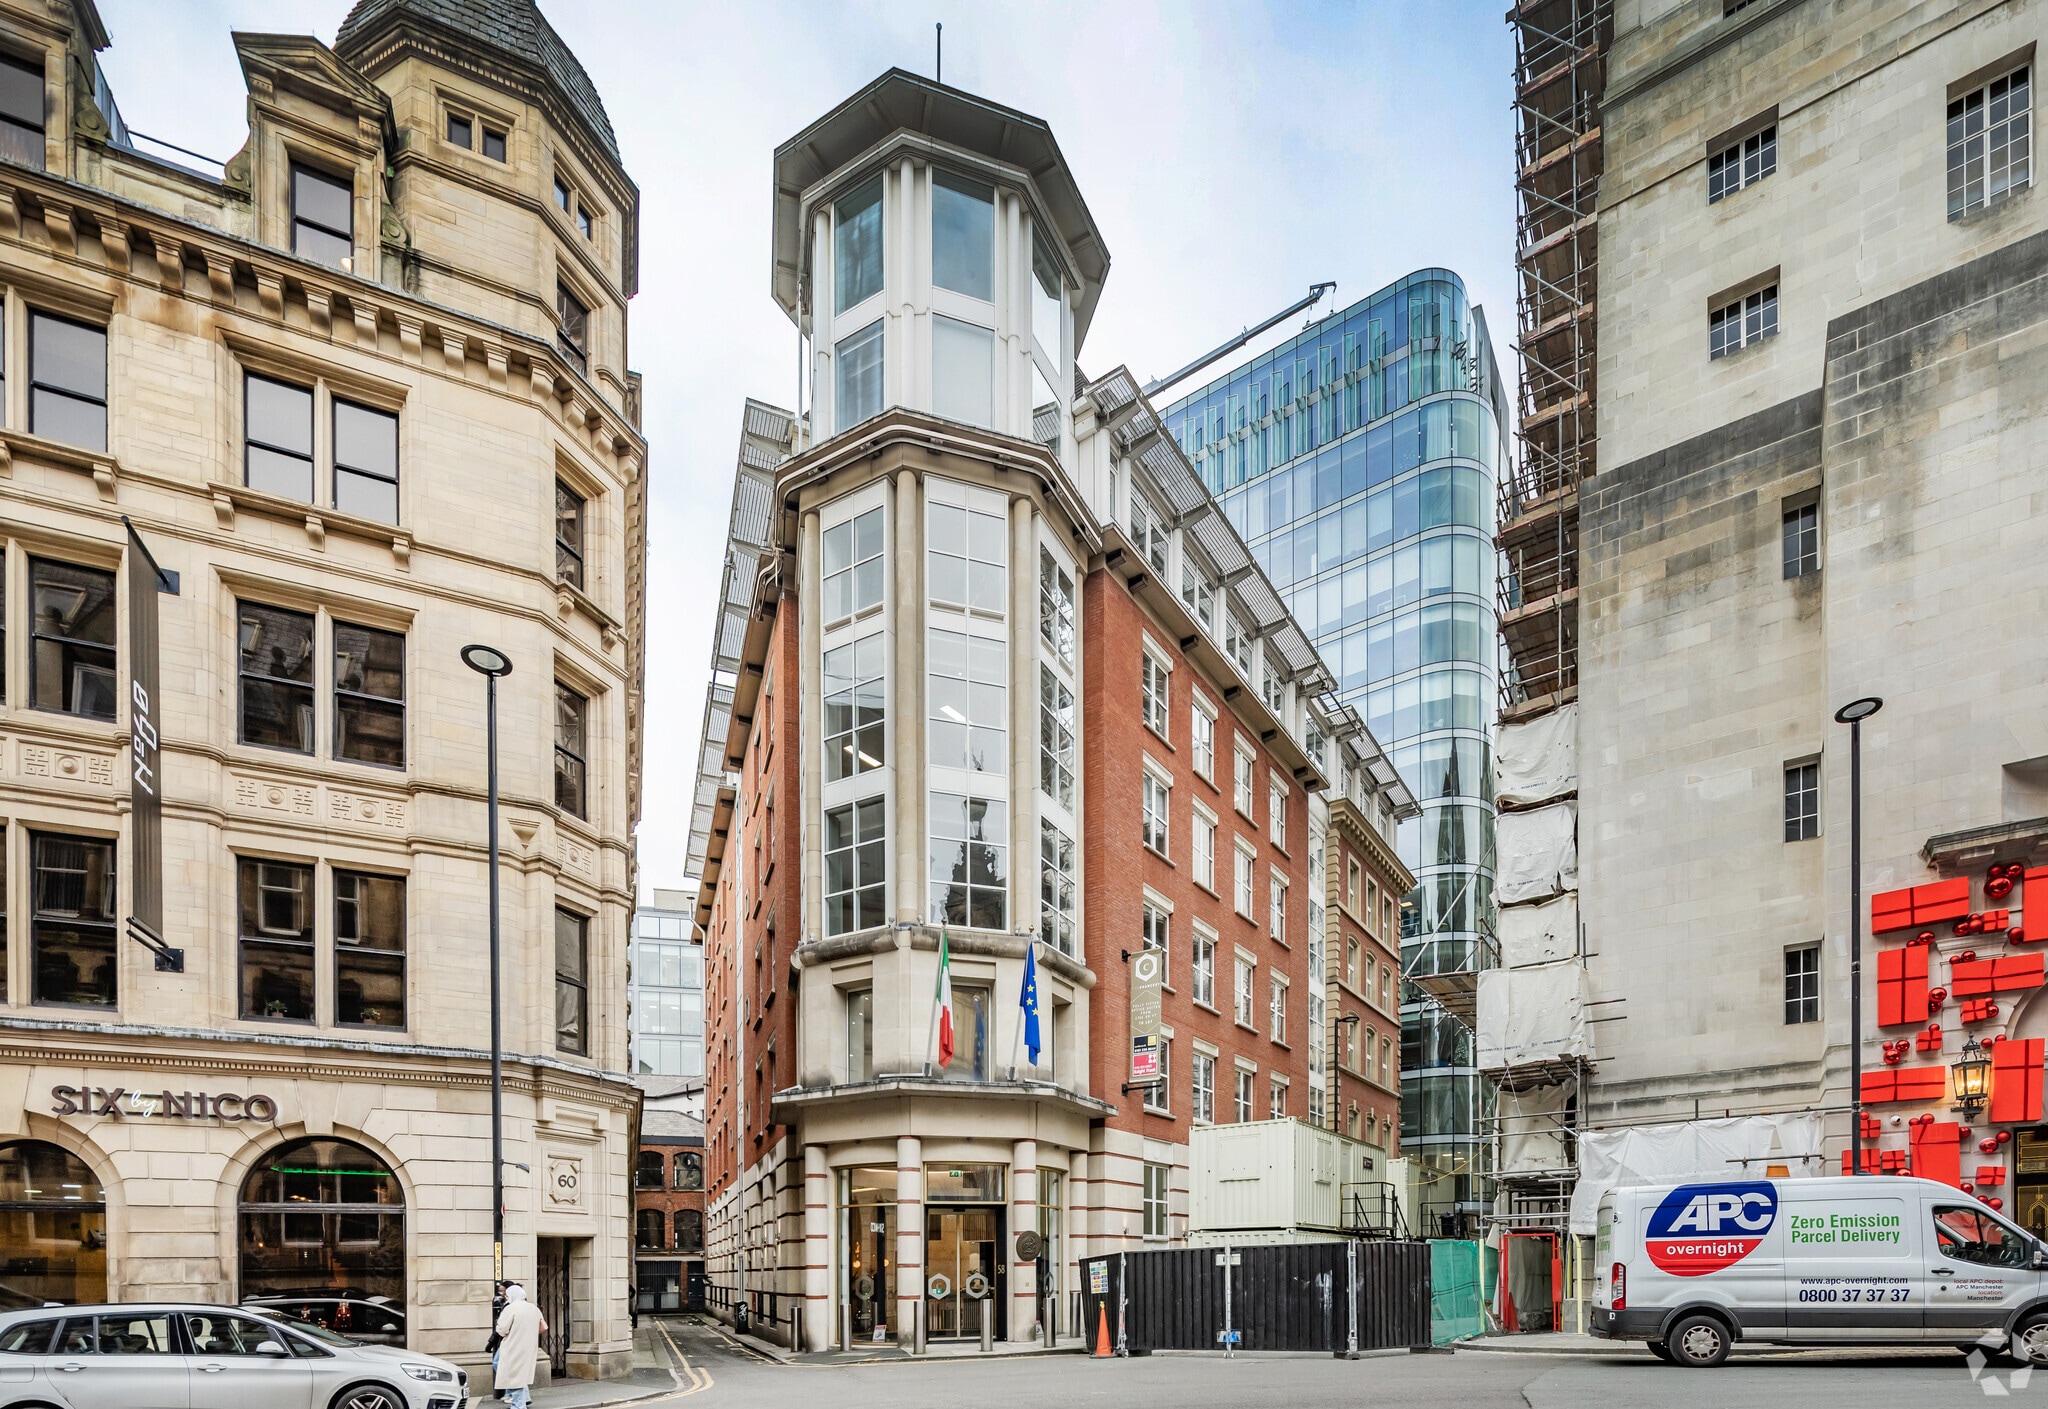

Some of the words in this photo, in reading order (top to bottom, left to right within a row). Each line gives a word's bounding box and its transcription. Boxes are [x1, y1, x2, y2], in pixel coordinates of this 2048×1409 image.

[51, 1085, 126, 1117] SIX
[130, 1089, 158, 1118] by
[162, 1090, 278, 1123] NICO
[557, 1174, 577, 1189] 60
[1667, 1191, 1773, 1232] APC
[1790, 1215, 1825, 1229] Zero
[1830, 1213, 1900, 1228] Emission
[1791, 1229, 1836, 1244] Parcel
[1841, 1229, 1900, 1245] Delivery
[1666, 1242, 1745, 1256] overnight
[997, 1264, 1006, 1274] 58
[1800, 1276, 1908, 1286] www.apc-overnight.com
[1798, 1289, 1837, 1303] 0800
[1841, 1289, 1861, 1303] 37
[1866, 1289, 1885, 1303] 37
[1890, 1289, 1910, 1303] 37
